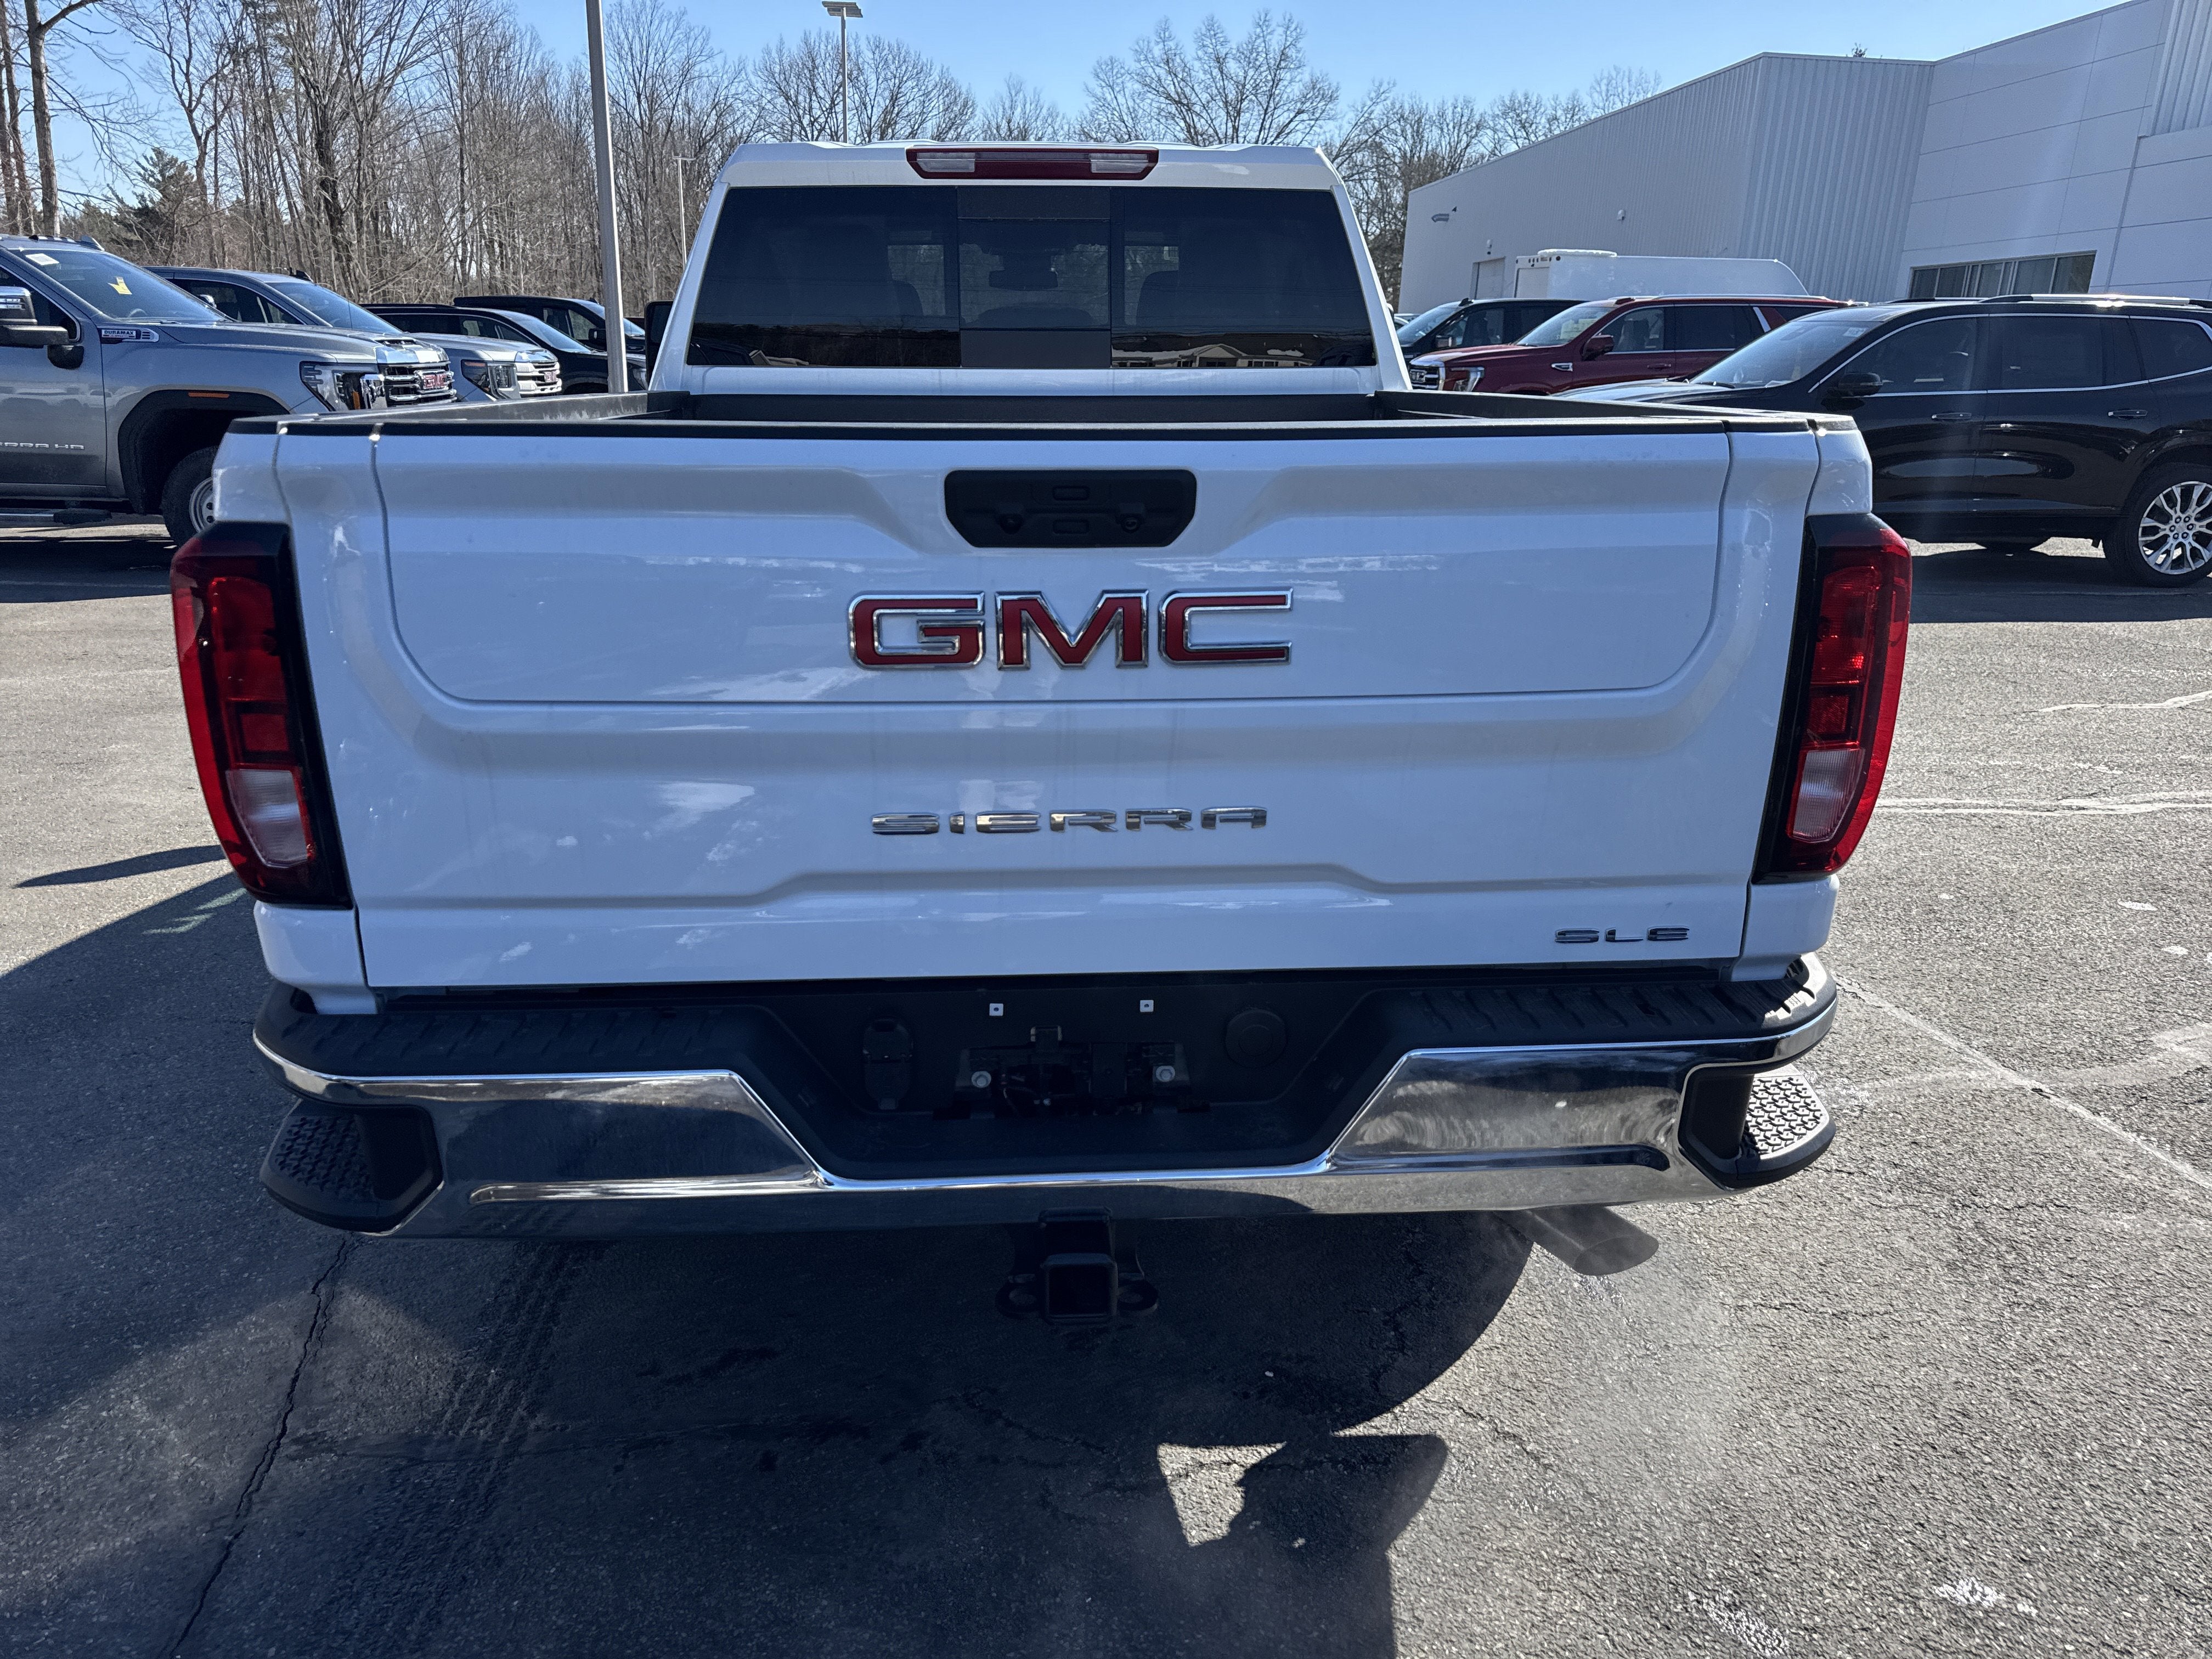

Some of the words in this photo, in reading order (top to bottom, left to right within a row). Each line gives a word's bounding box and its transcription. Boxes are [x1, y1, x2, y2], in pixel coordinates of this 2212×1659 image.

[848, 588, 1293, 670] GMC
[871, 807, 1267, 834] SIERRA
[1555, 927, 1690, 944] SLE
